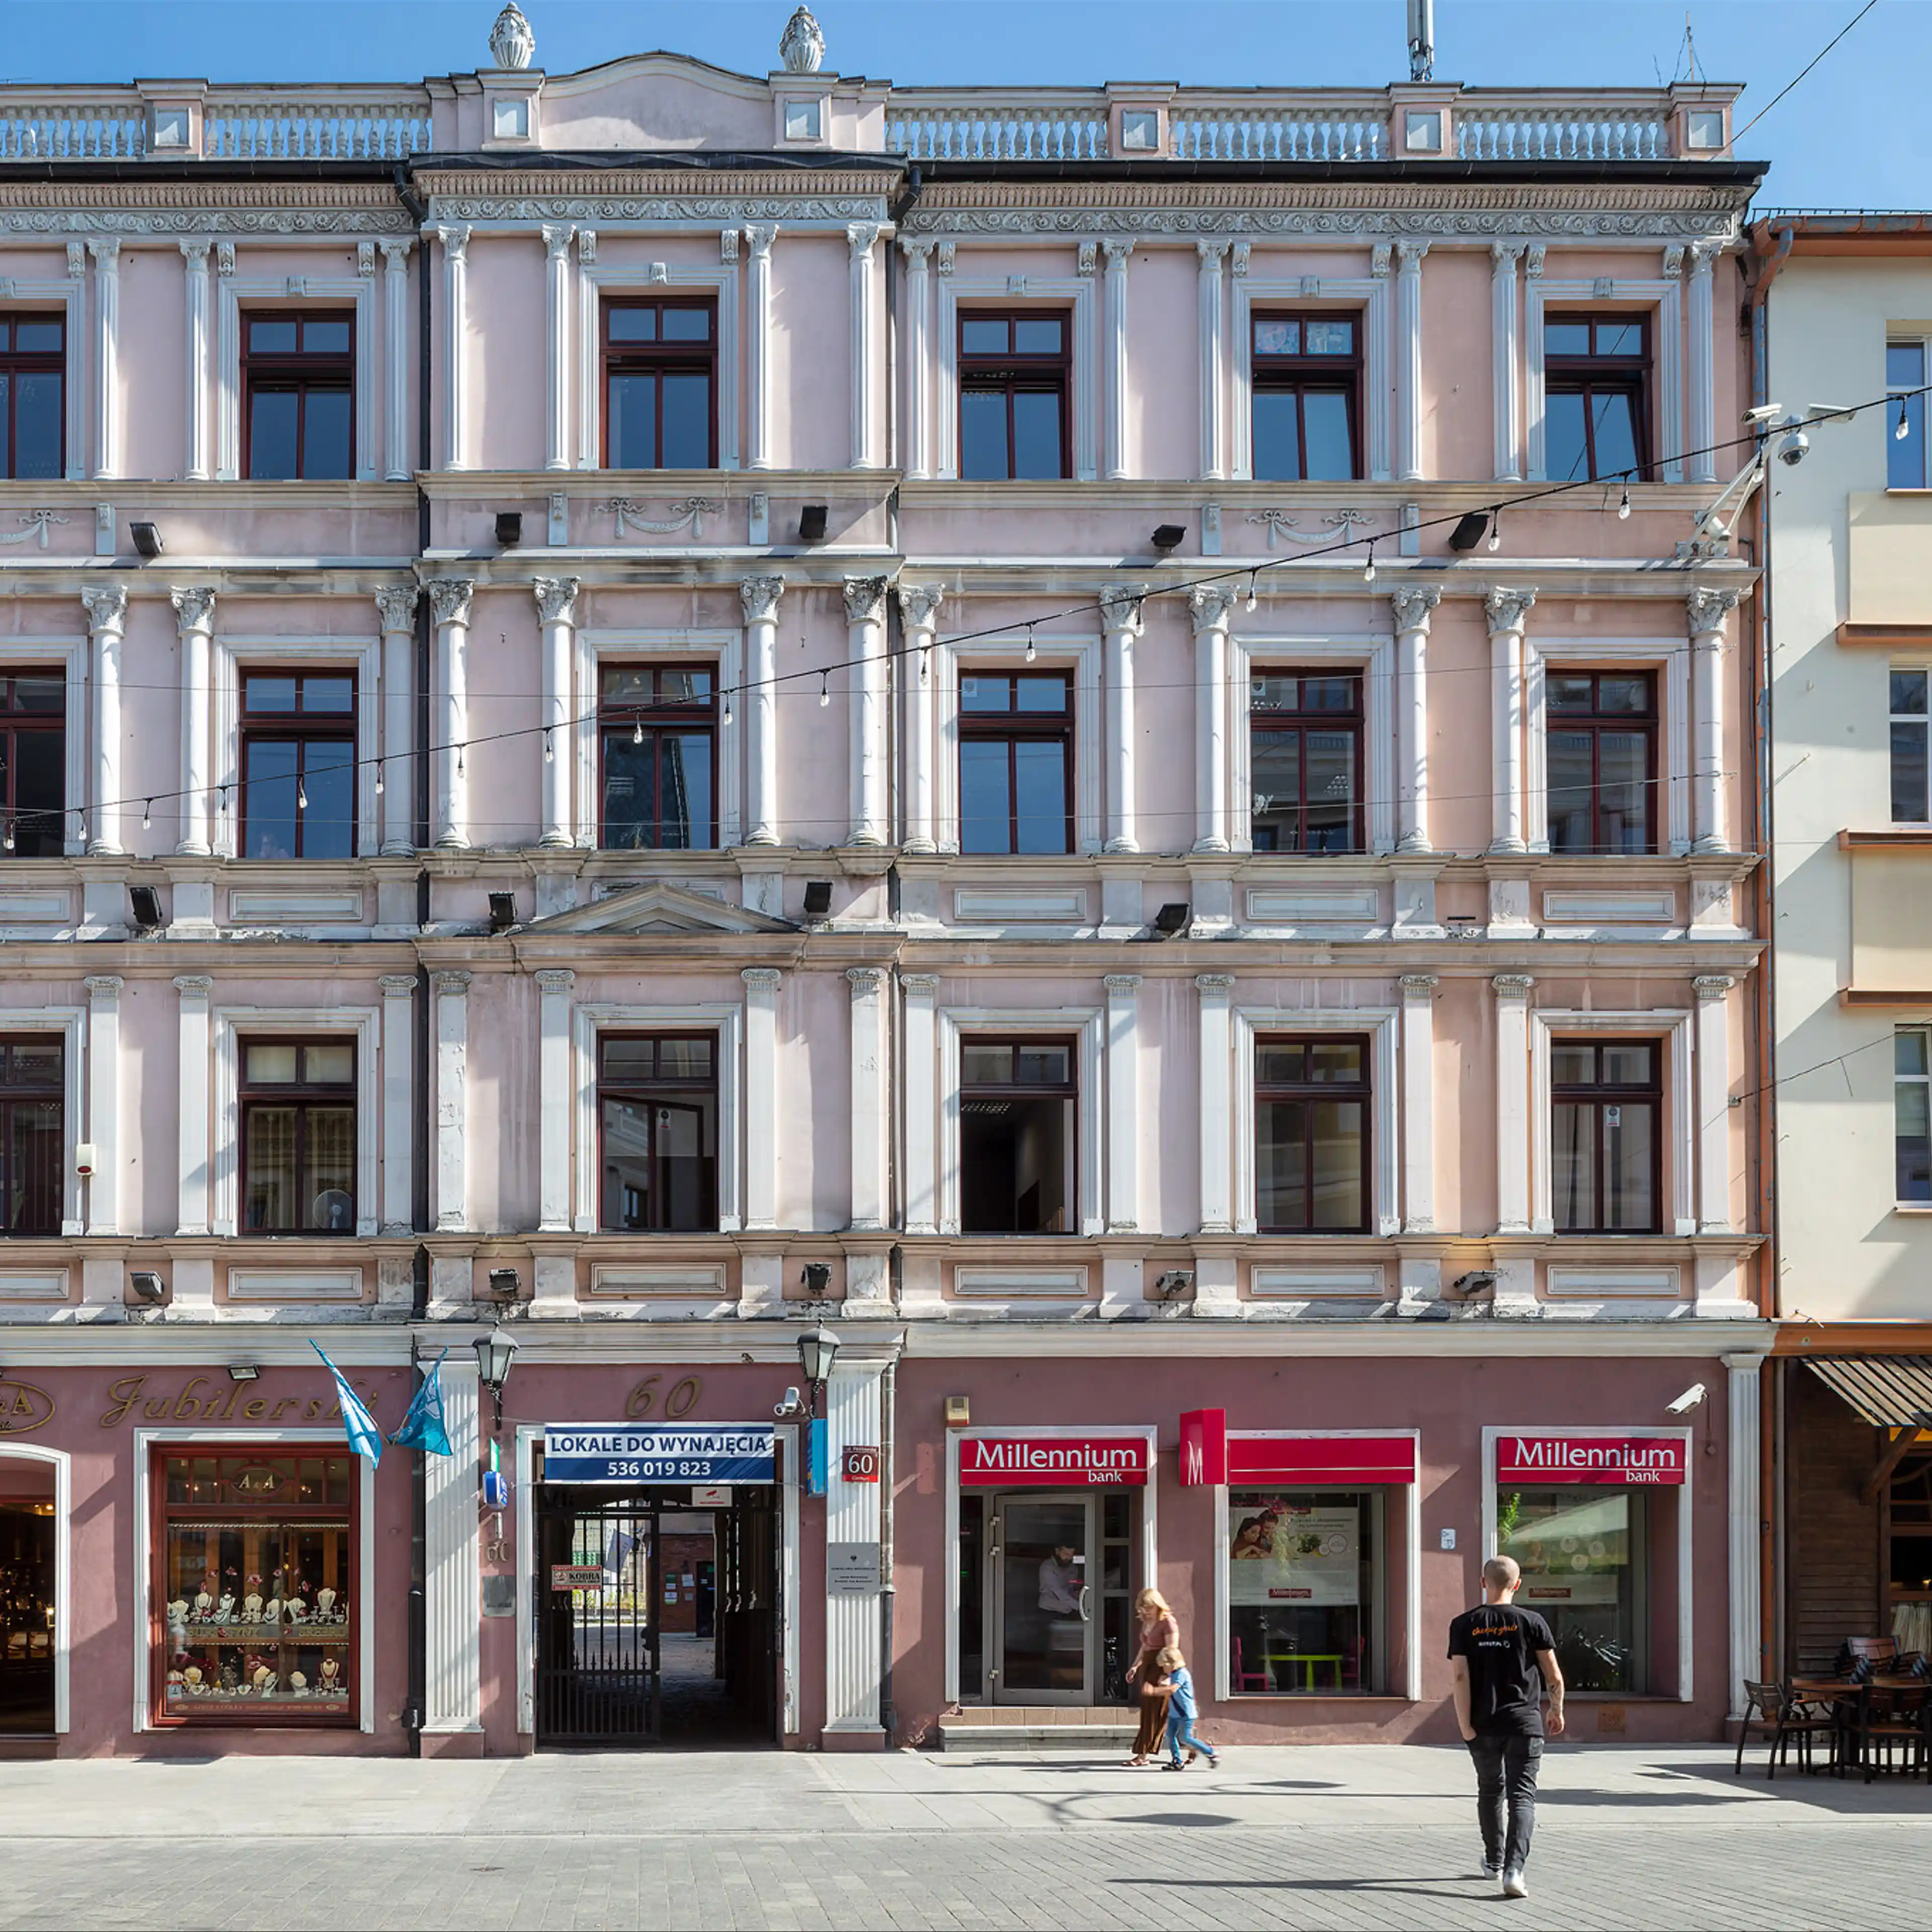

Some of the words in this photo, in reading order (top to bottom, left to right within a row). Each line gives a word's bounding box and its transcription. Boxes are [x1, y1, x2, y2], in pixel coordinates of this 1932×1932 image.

[625, 1374, 703, 1418] 60
[551, 1437, 622, 1452] LOKALE
[627, 1437, 655, 1452] DO
[659, 1437, 767, 1455] WYNAJĘCIA
[975, 1440, 1137, 1468] Millennium
[1515, 1437, 1675, 1467] Millennium
[608, 1462, 639, 1476] 536
[643, 1462, 675, 1476] 019
[680, 1462, 711, 1476] 823
[849, 1454, 872, 1473] 60
[1188, 1440, 1203, 1486] M
[1088, 1470, 1123, 1482] bank
[1626, 1470, 1660, 1482] bank
